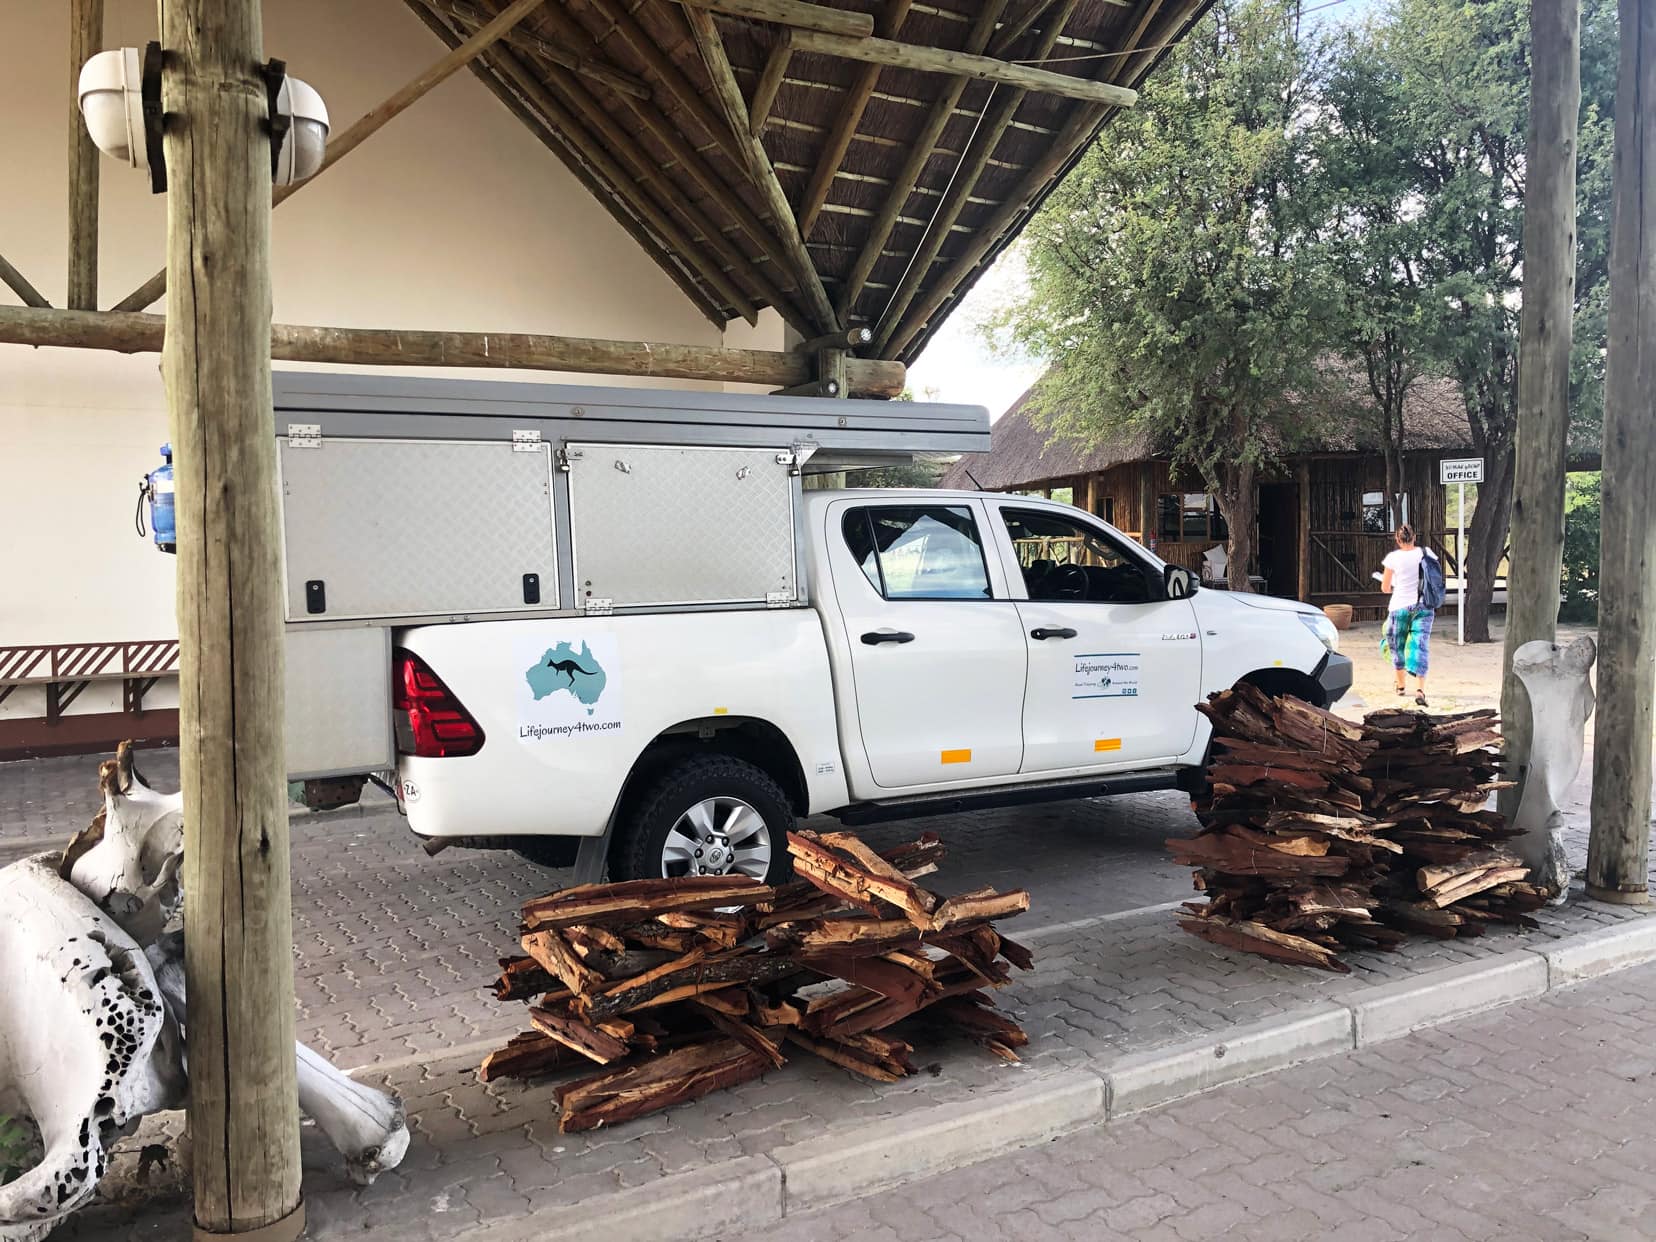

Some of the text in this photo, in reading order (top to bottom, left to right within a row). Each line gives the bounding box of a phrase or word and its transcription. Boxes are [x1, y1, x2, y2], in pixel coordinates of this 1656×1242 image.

[1447, 471, 1479, 480] OFFICE
[519, 721, 622, 740] Lifejourney4two.com
[405, 783, 417, 797] ZA
